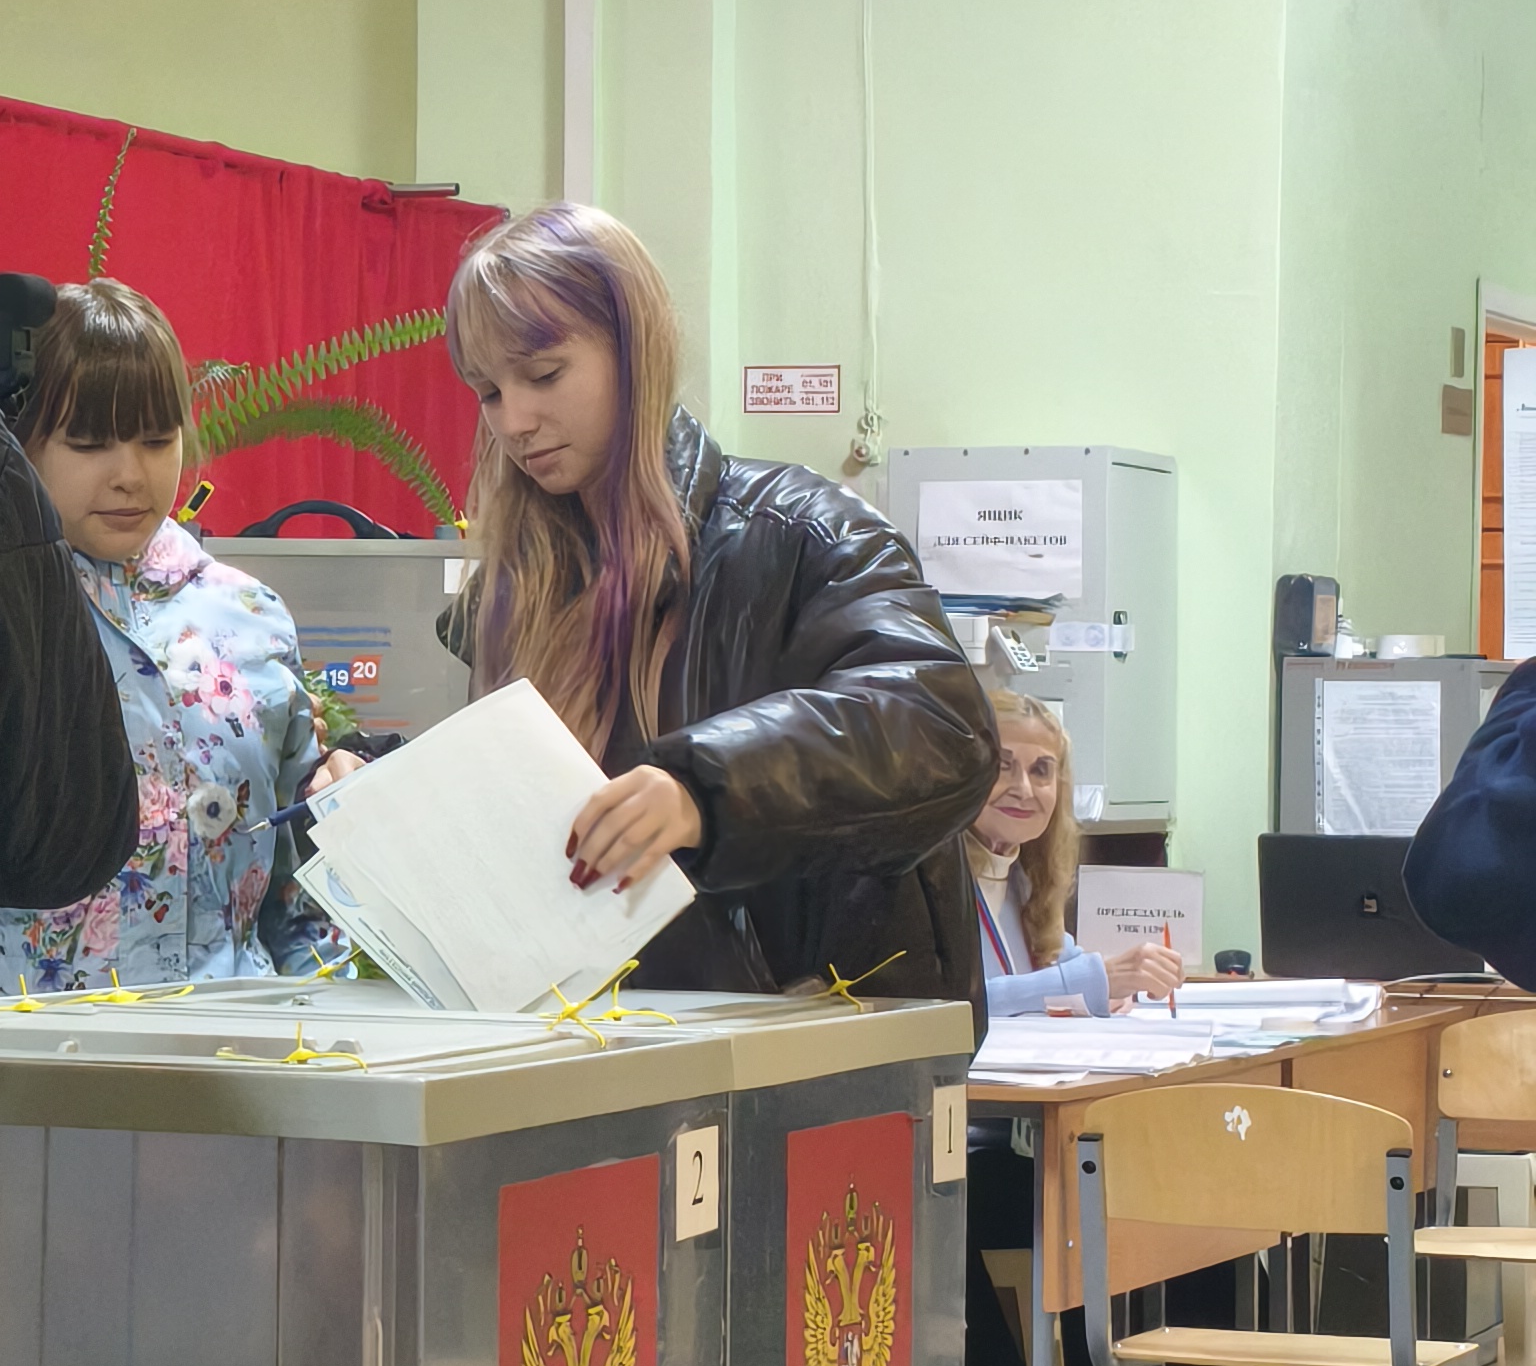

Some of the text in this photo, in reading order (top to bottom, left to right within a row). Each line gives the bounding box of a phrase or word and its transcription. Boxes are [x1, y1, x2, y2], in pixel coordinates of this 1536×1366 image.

[762, 373, 783, 382] ПРИ
[750, 384, 794, 394] ПОЖАРЕ
[977, 510, 1023, 522] ЯЩИК
[329, 661, 376, 686] 19 20
[947, 1104, 953, 1154] 1
[691, 1150, 704, 1206] 2
